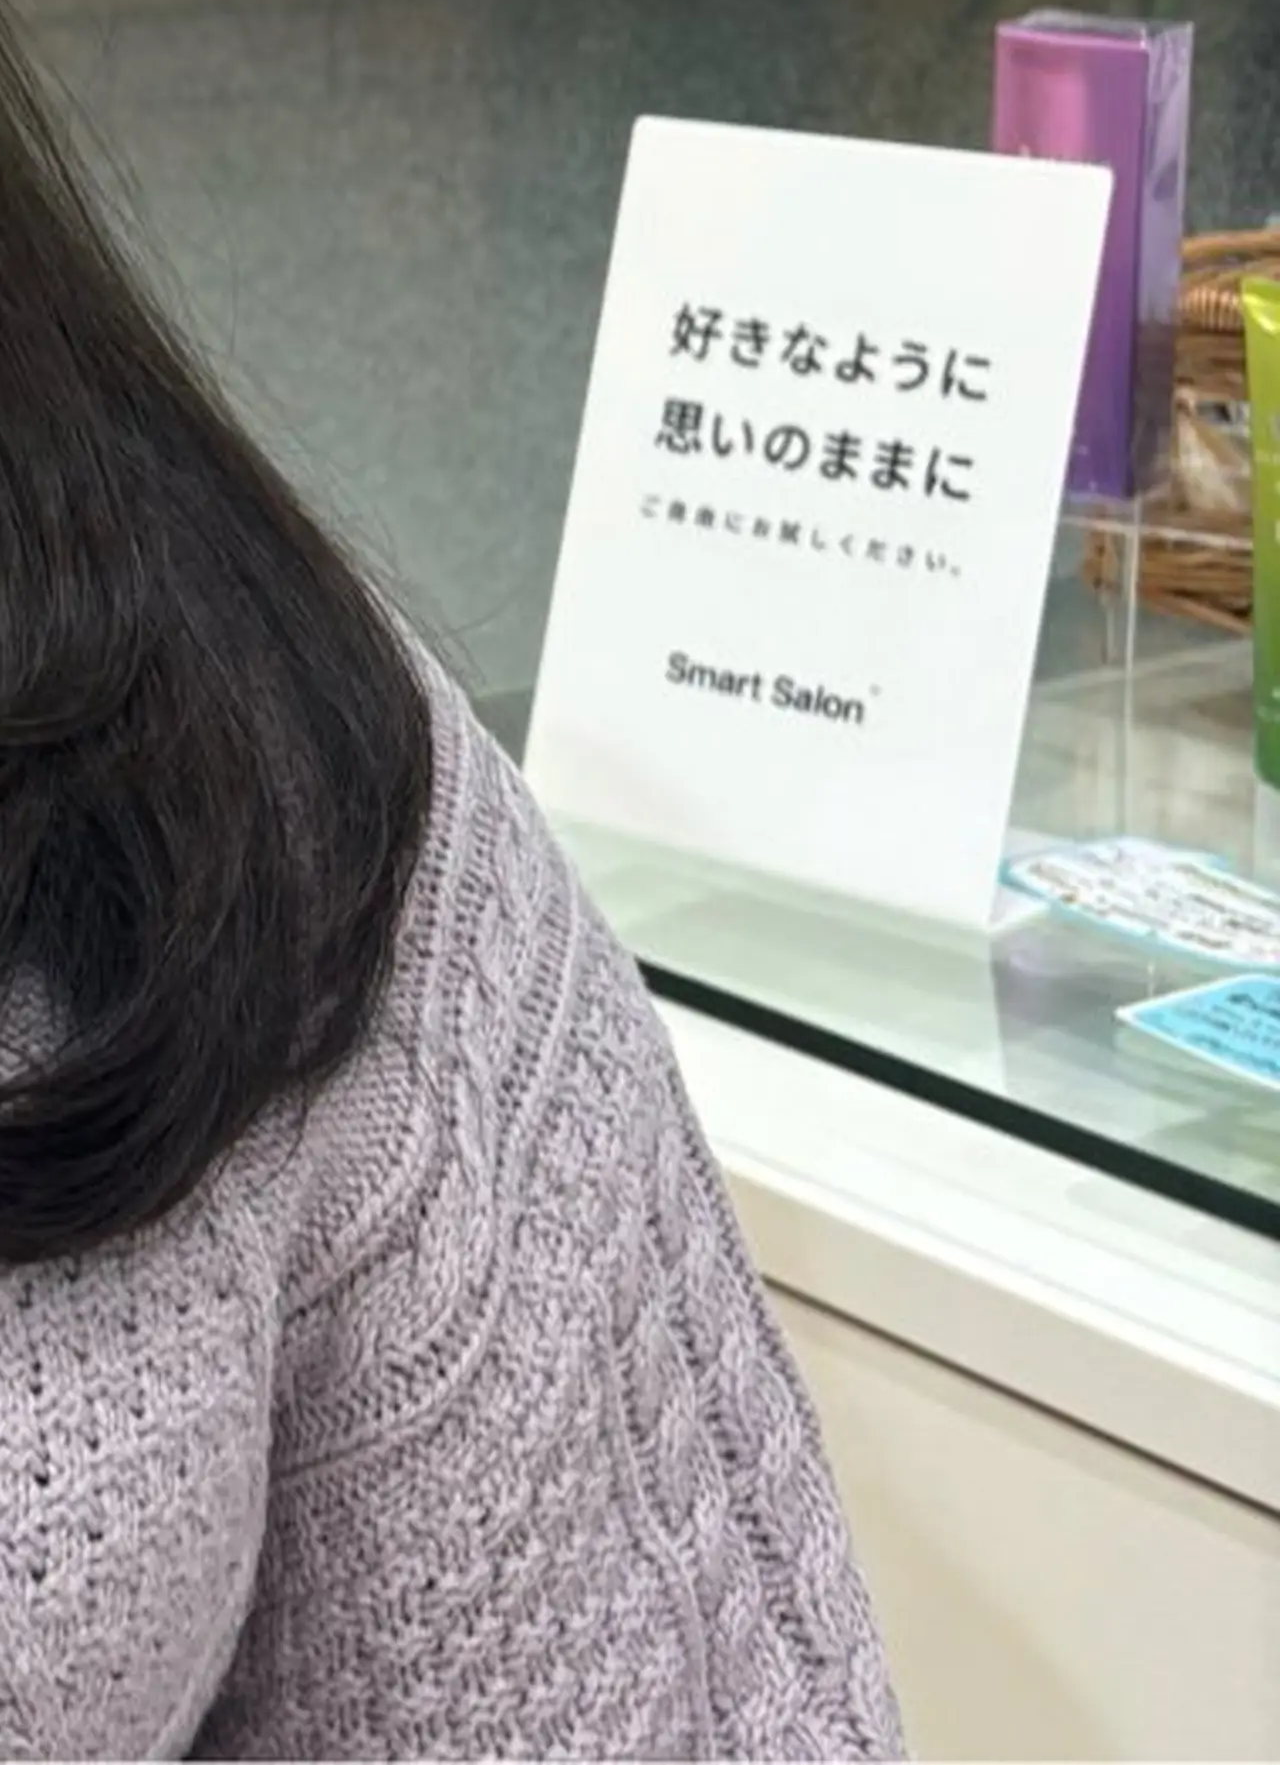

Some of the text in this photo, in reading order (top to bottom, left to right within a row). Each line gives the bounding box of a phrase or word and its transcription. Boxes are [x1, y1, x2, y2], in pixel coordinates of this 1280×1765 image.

[669, 302, 992, 403] 好きなように
[654, 397, 975, 503] 思いのままに
[666, 651, 865, 725] Smart Salon
